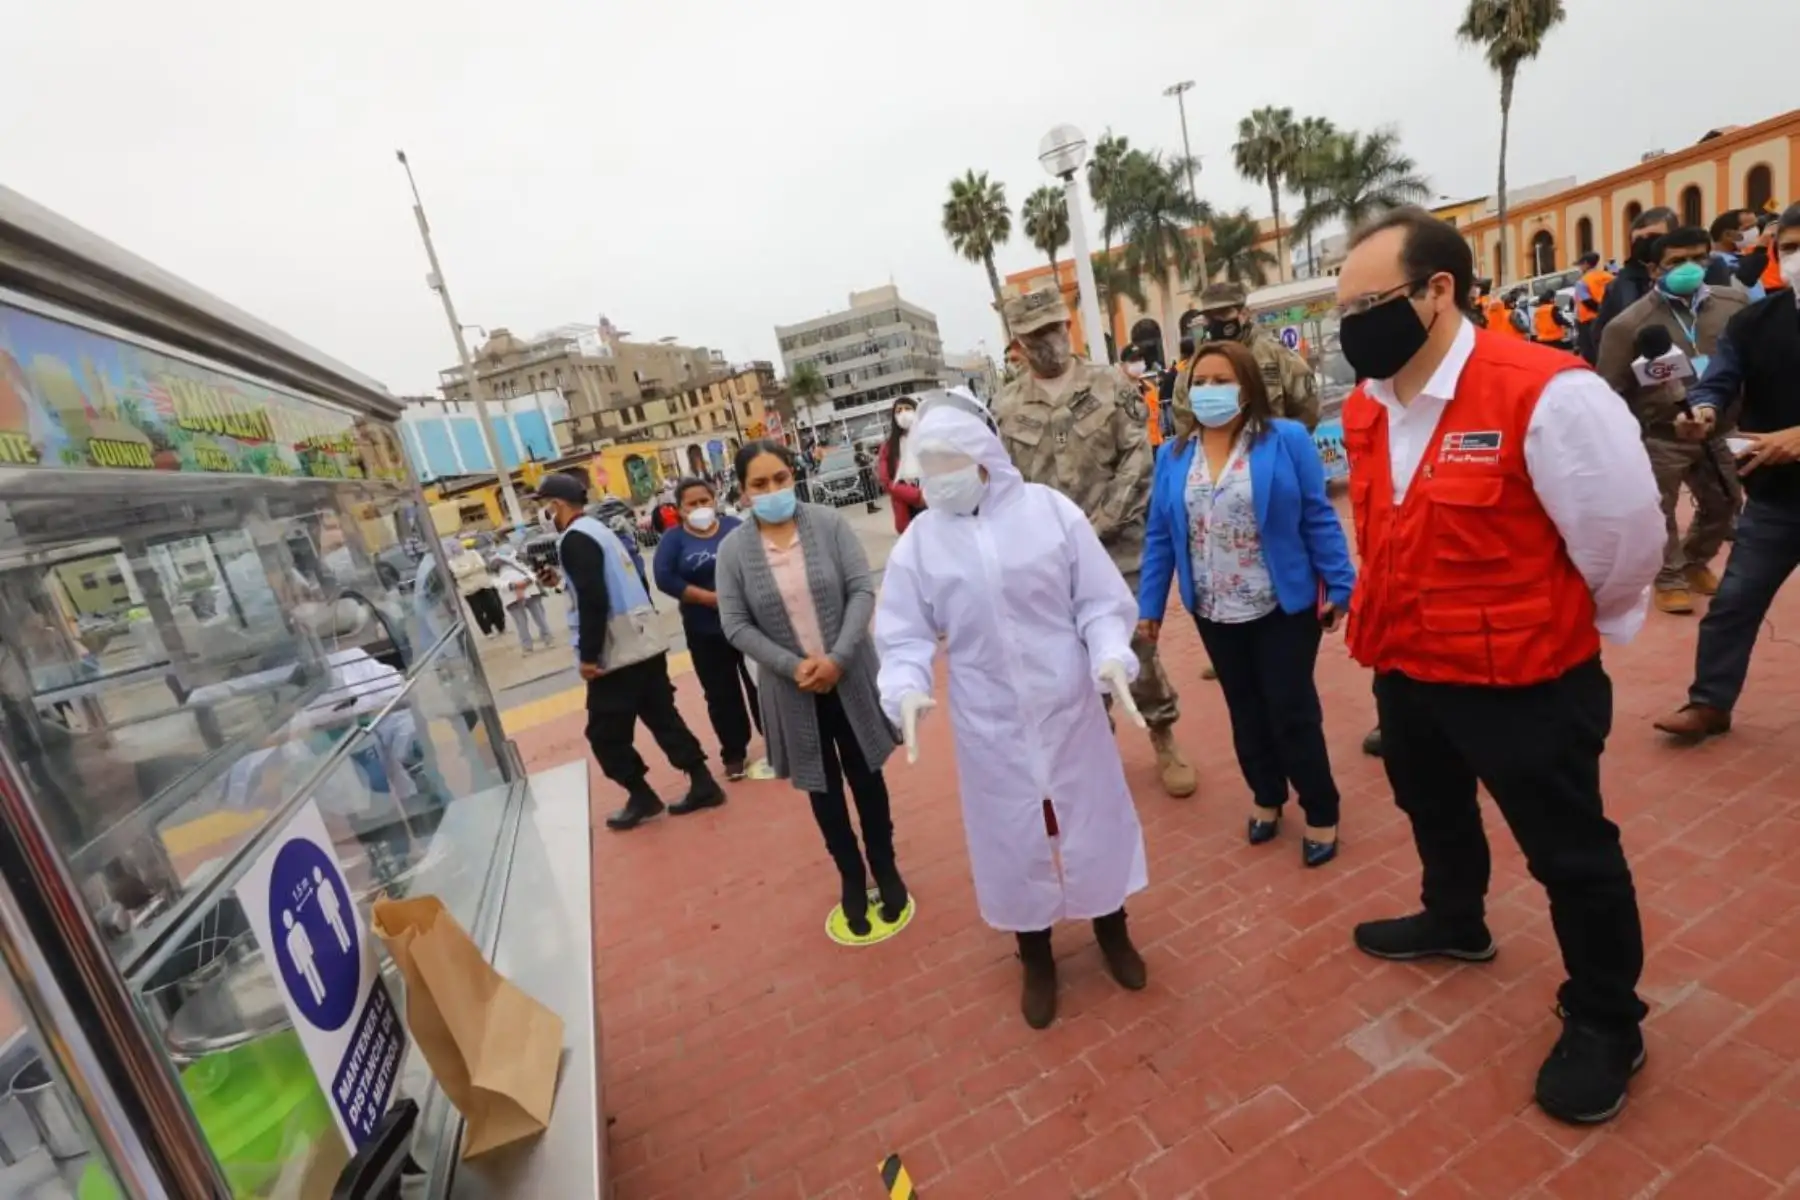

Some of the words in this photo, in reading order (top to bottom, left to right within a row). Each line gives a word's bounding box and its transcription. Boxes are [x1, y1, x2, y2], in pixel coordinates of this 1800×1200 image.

[88, 437, 155, 468] QUINUA
[338, 1007, 379, 1104] MANTENER
[374, 989, 386, 1013] LA
[349, 1031, 387, 1127] DISTANCIA
[381, 1007, 394, 1034] DE
[362, 1102, 377, 1136] 1.5
[372, 1034, 399, 1108] METROS
